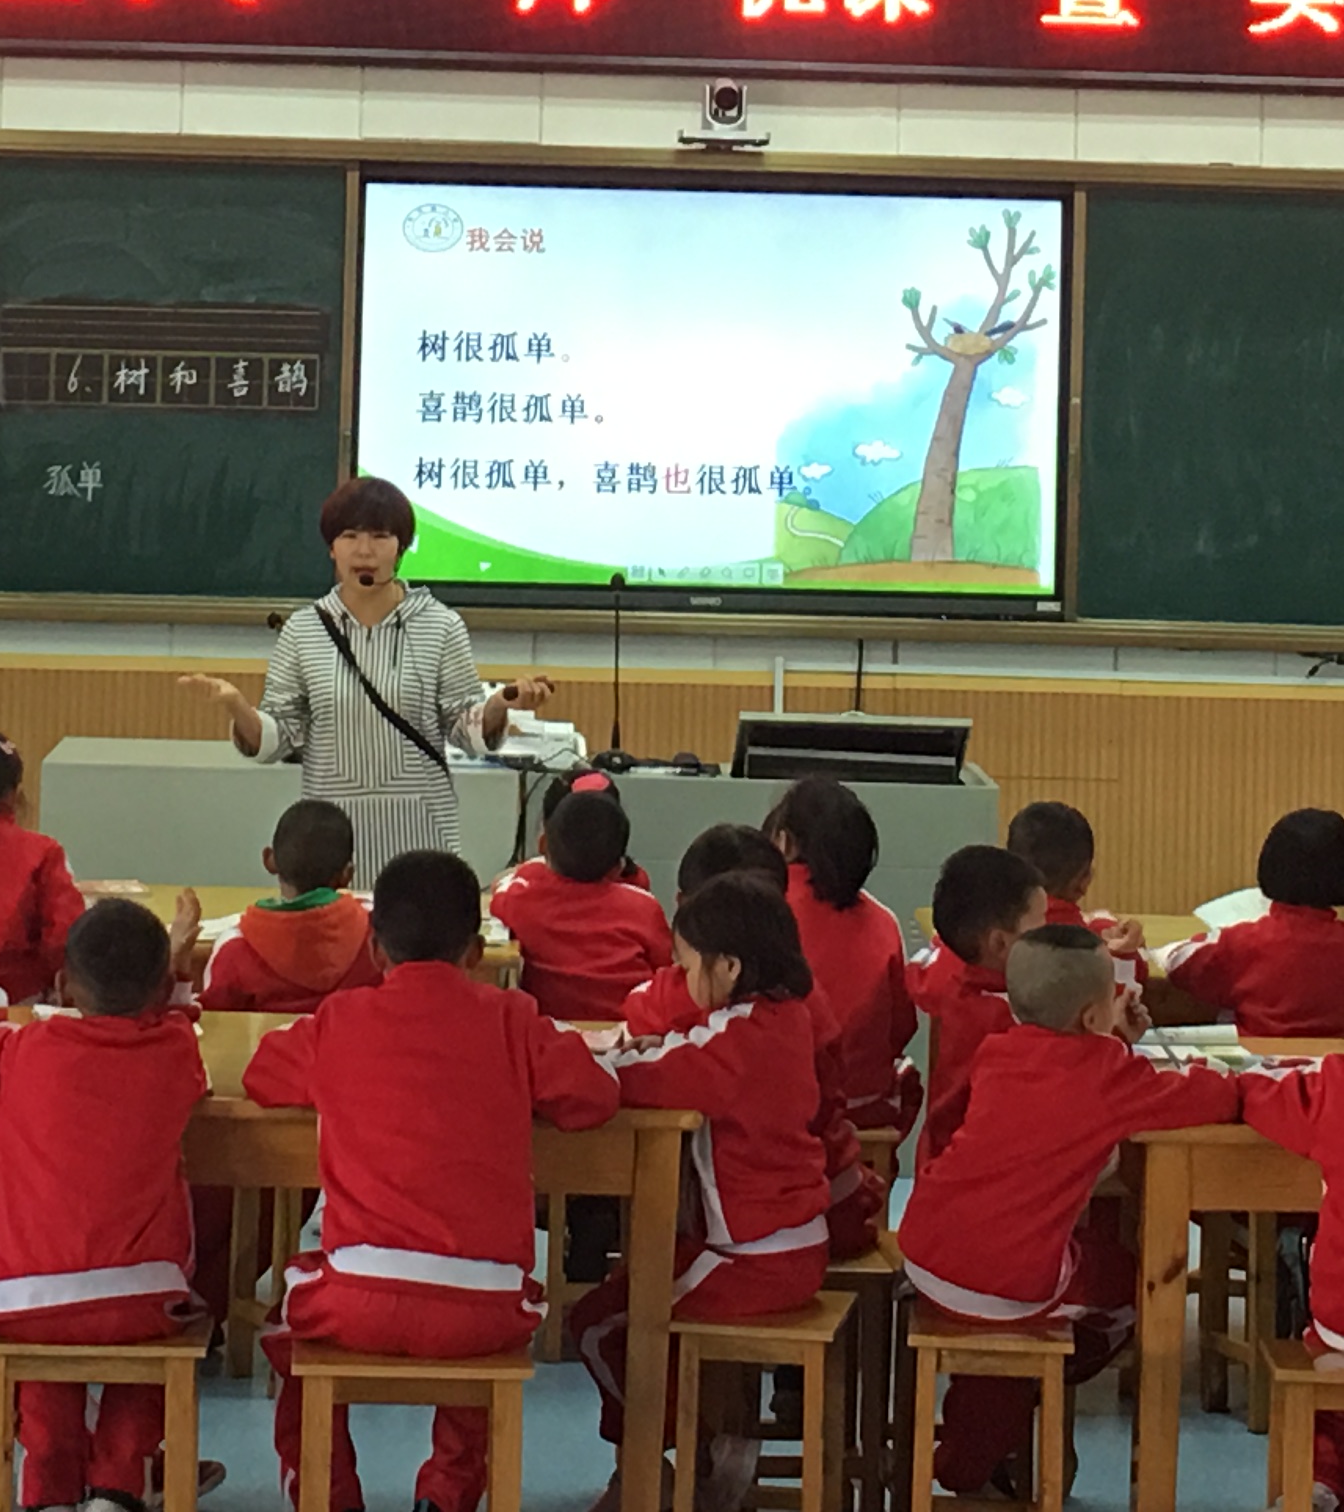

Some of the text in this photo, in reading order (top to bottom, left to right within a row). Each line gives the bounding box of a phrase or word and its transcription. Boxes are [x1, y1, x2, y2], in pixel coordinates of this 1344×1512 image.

[466, 227, 546, 253] 我会说
[417, 329, 570, 364] 树很孤单。
[416, 390, 604, 425] 喜鹊很孤单。
[43, 460, 103, 502] 孤单
